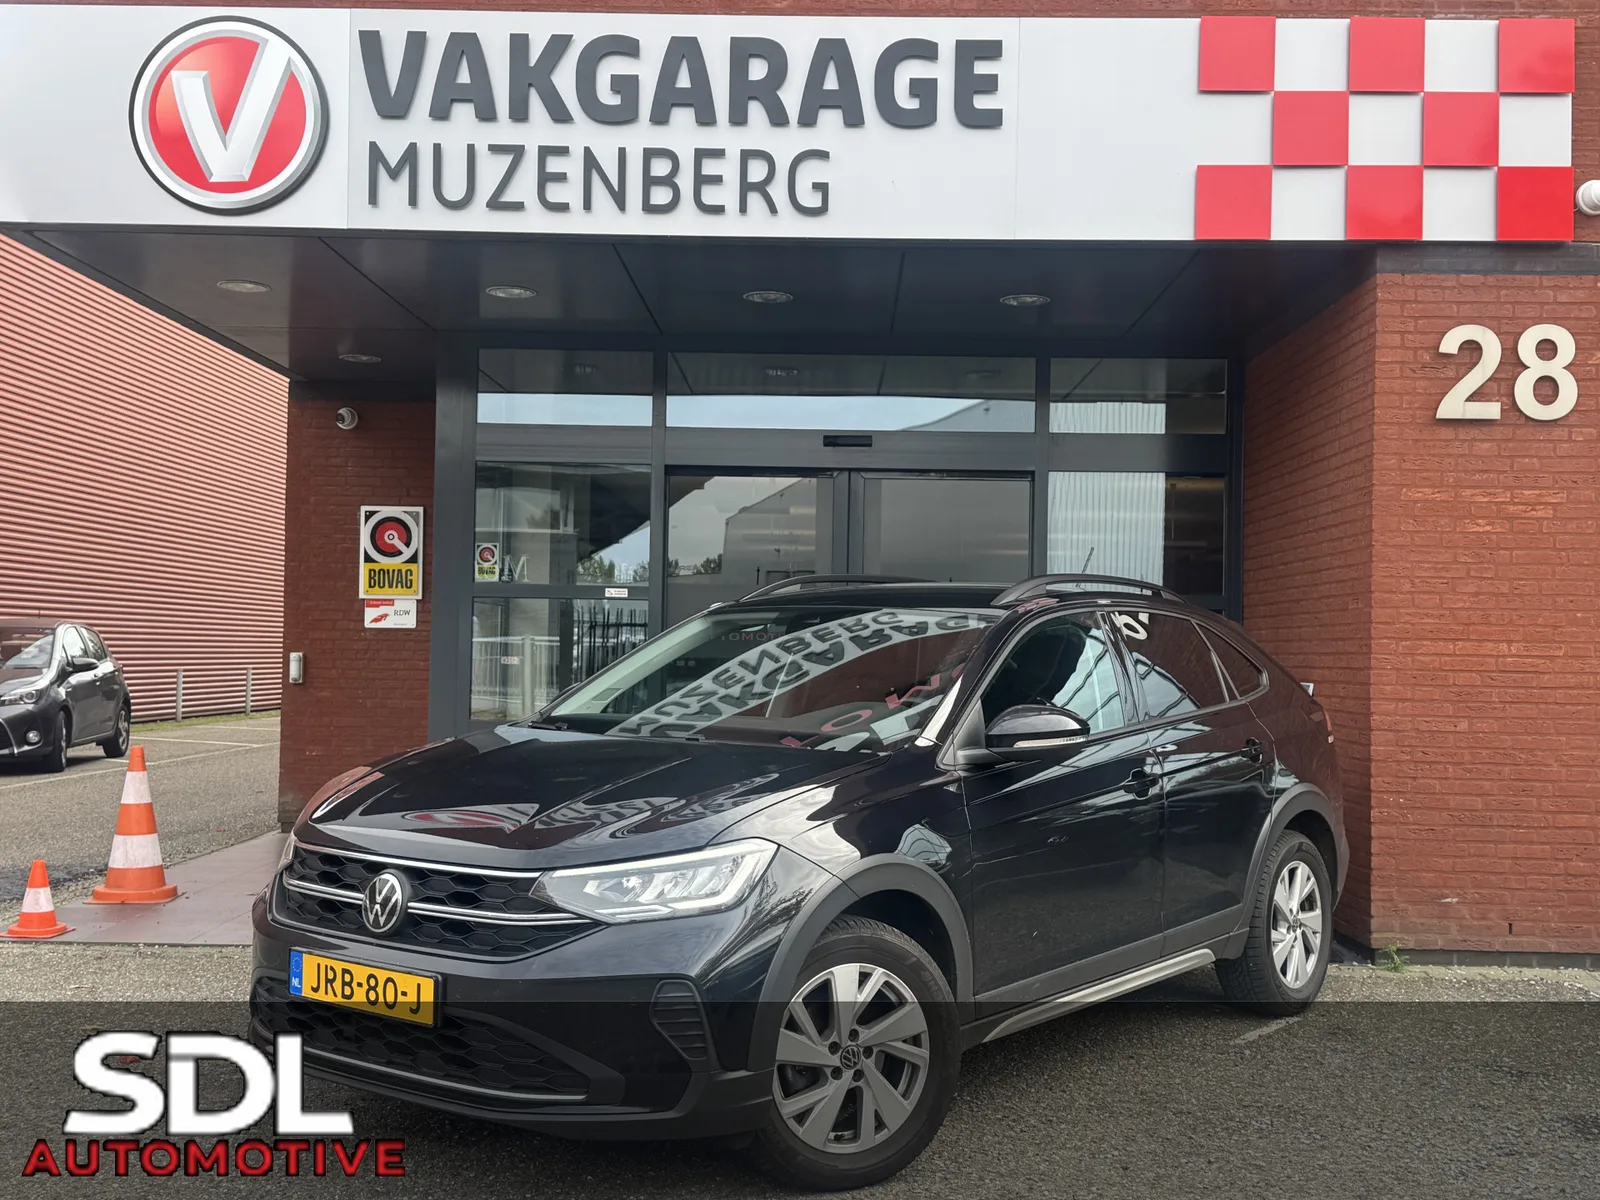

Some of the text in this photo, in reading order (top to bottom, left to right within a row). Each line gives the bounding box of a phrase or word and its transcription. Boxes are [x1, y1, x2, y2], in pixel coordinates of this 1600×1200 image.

[357, 29, 1004, 130] VAKGARAGE
[367, 140, 832, 217] MUZENBERG
[1435, 323, 1579, 421] 28
[368, 567, 414, 590] BOVAG
[291, 976, 302, 988] NL
[310, 962, 422, 1015] JRB-80-J
